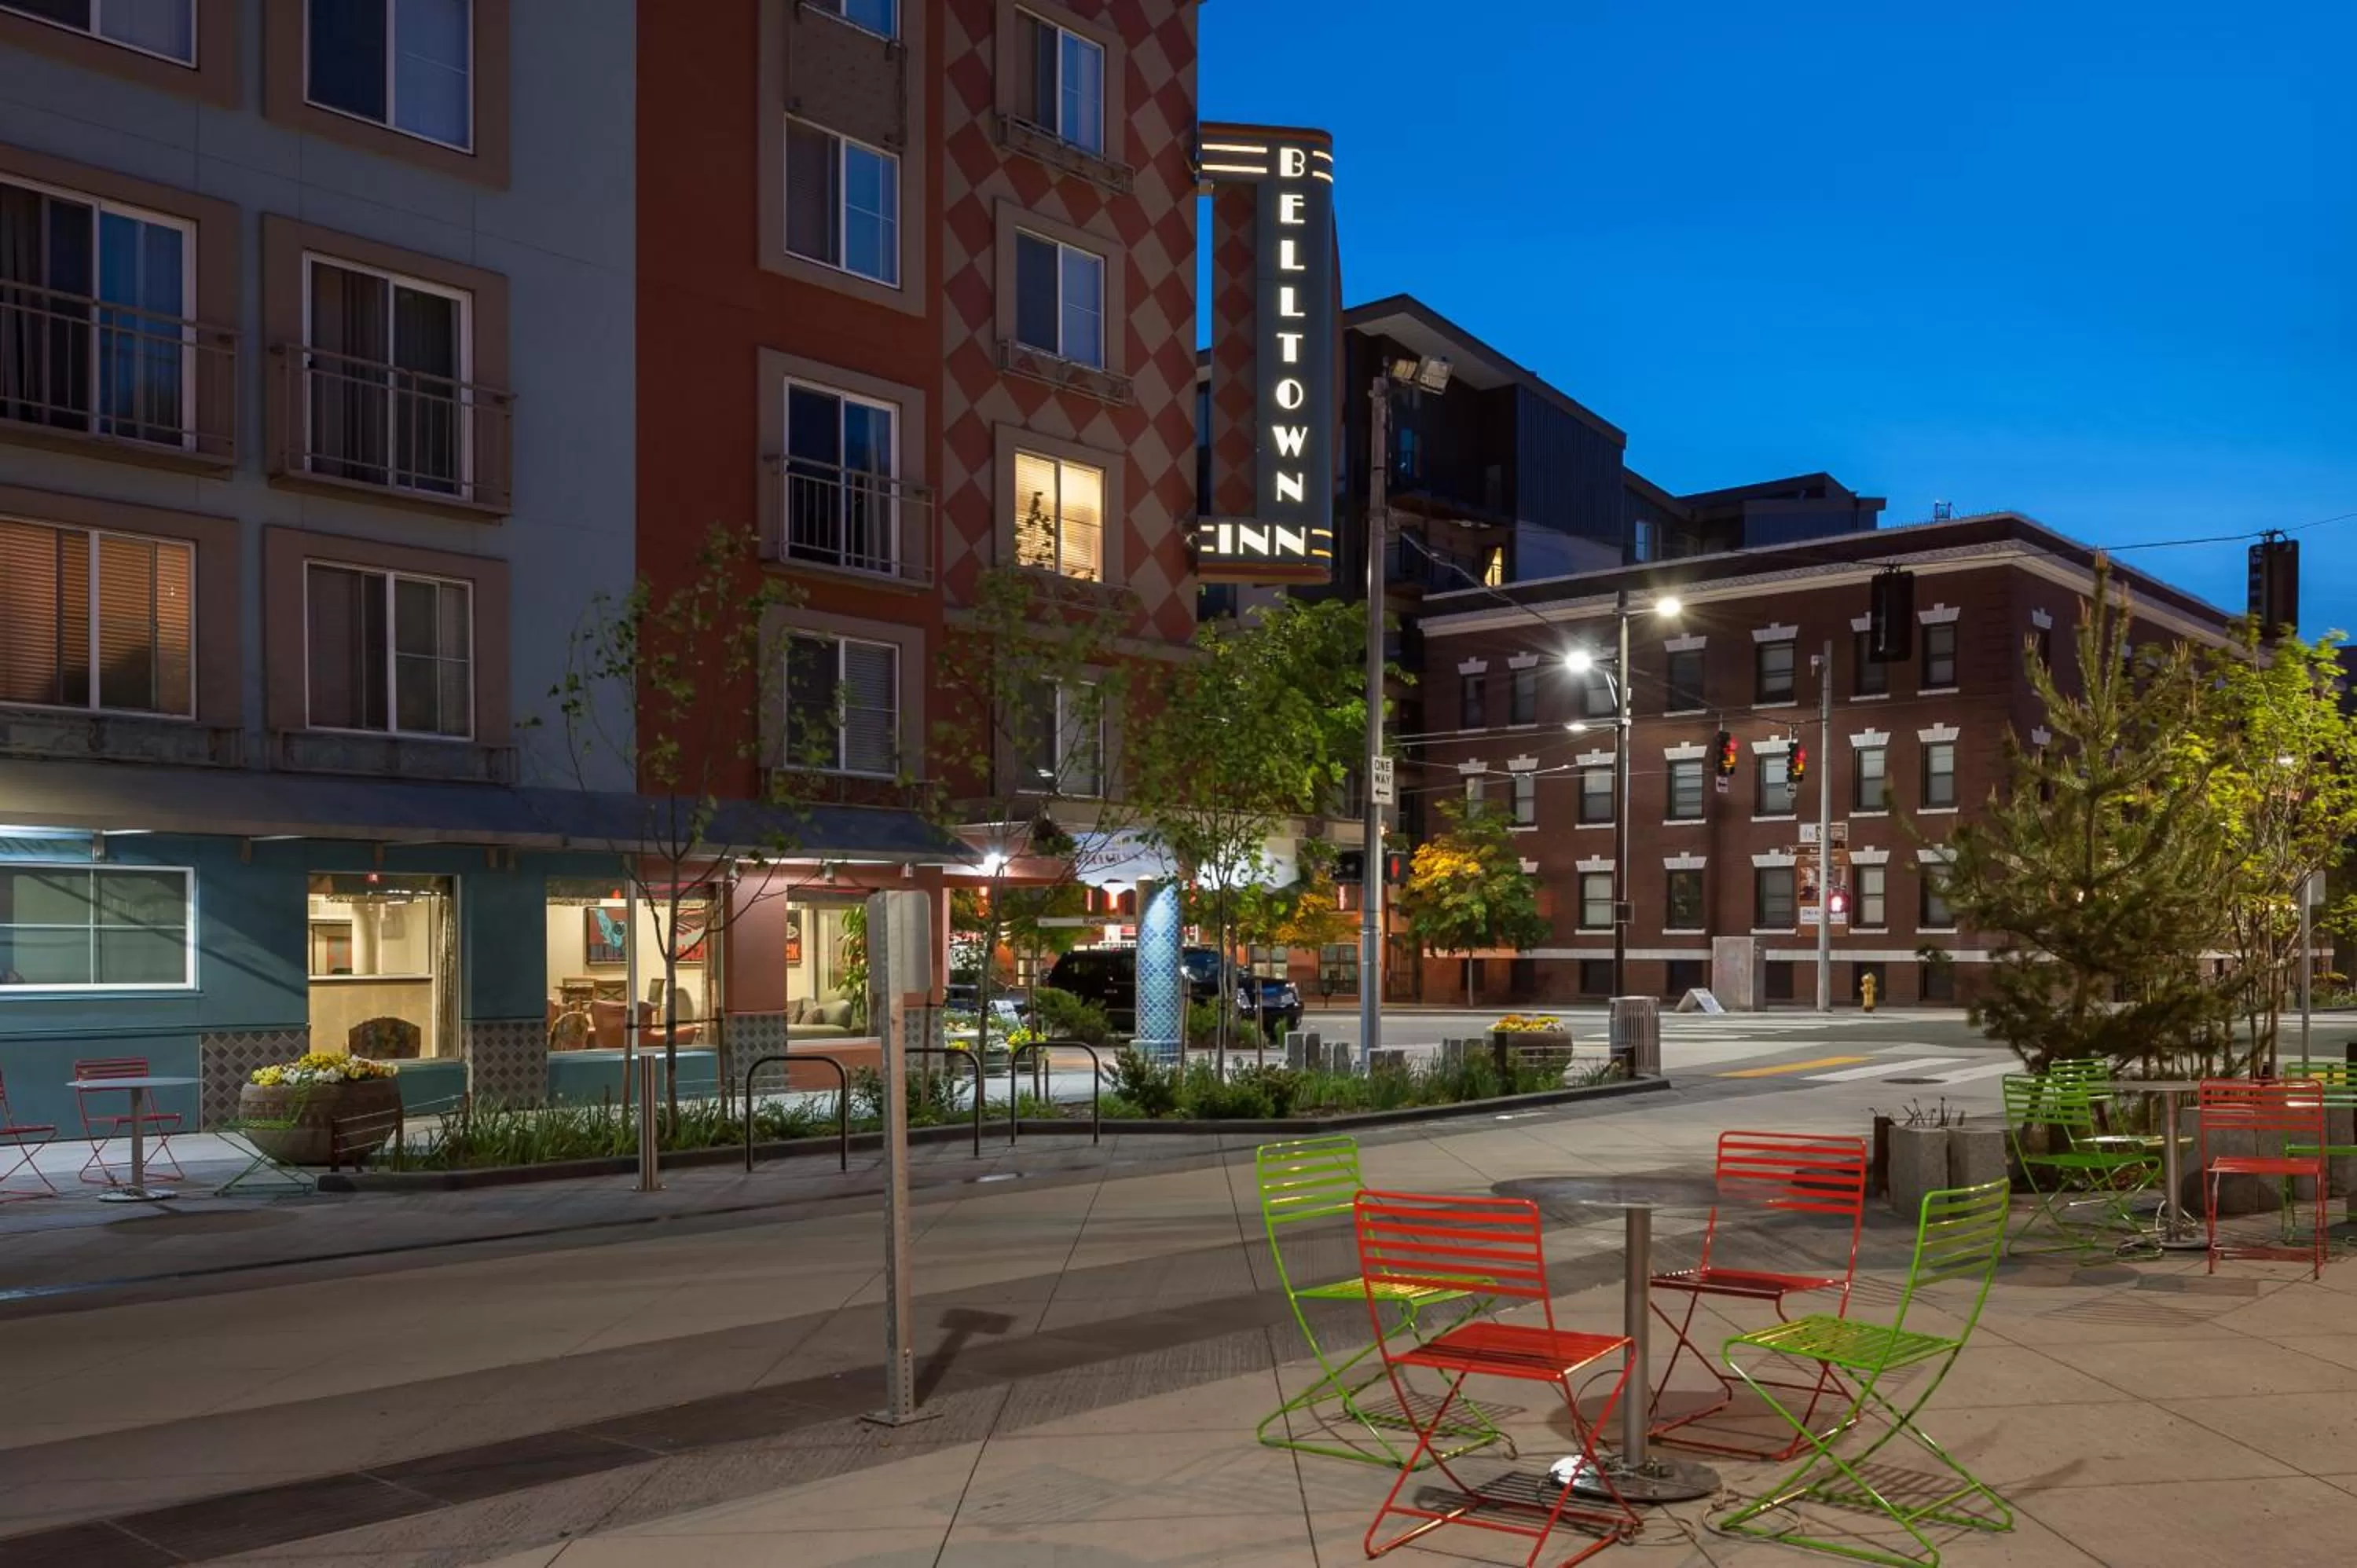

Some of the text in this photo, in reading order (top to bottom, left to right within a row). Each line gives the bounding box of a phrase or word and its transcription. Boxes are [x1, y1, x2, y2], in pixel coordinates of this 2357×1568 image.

[1273, 147, 1307, 502] BELLTOWN
[1219, 524, 1306, 555] INN
[1374, 759, 1391, 771] ONE
[1374, 774, 1391, 785] WAY
